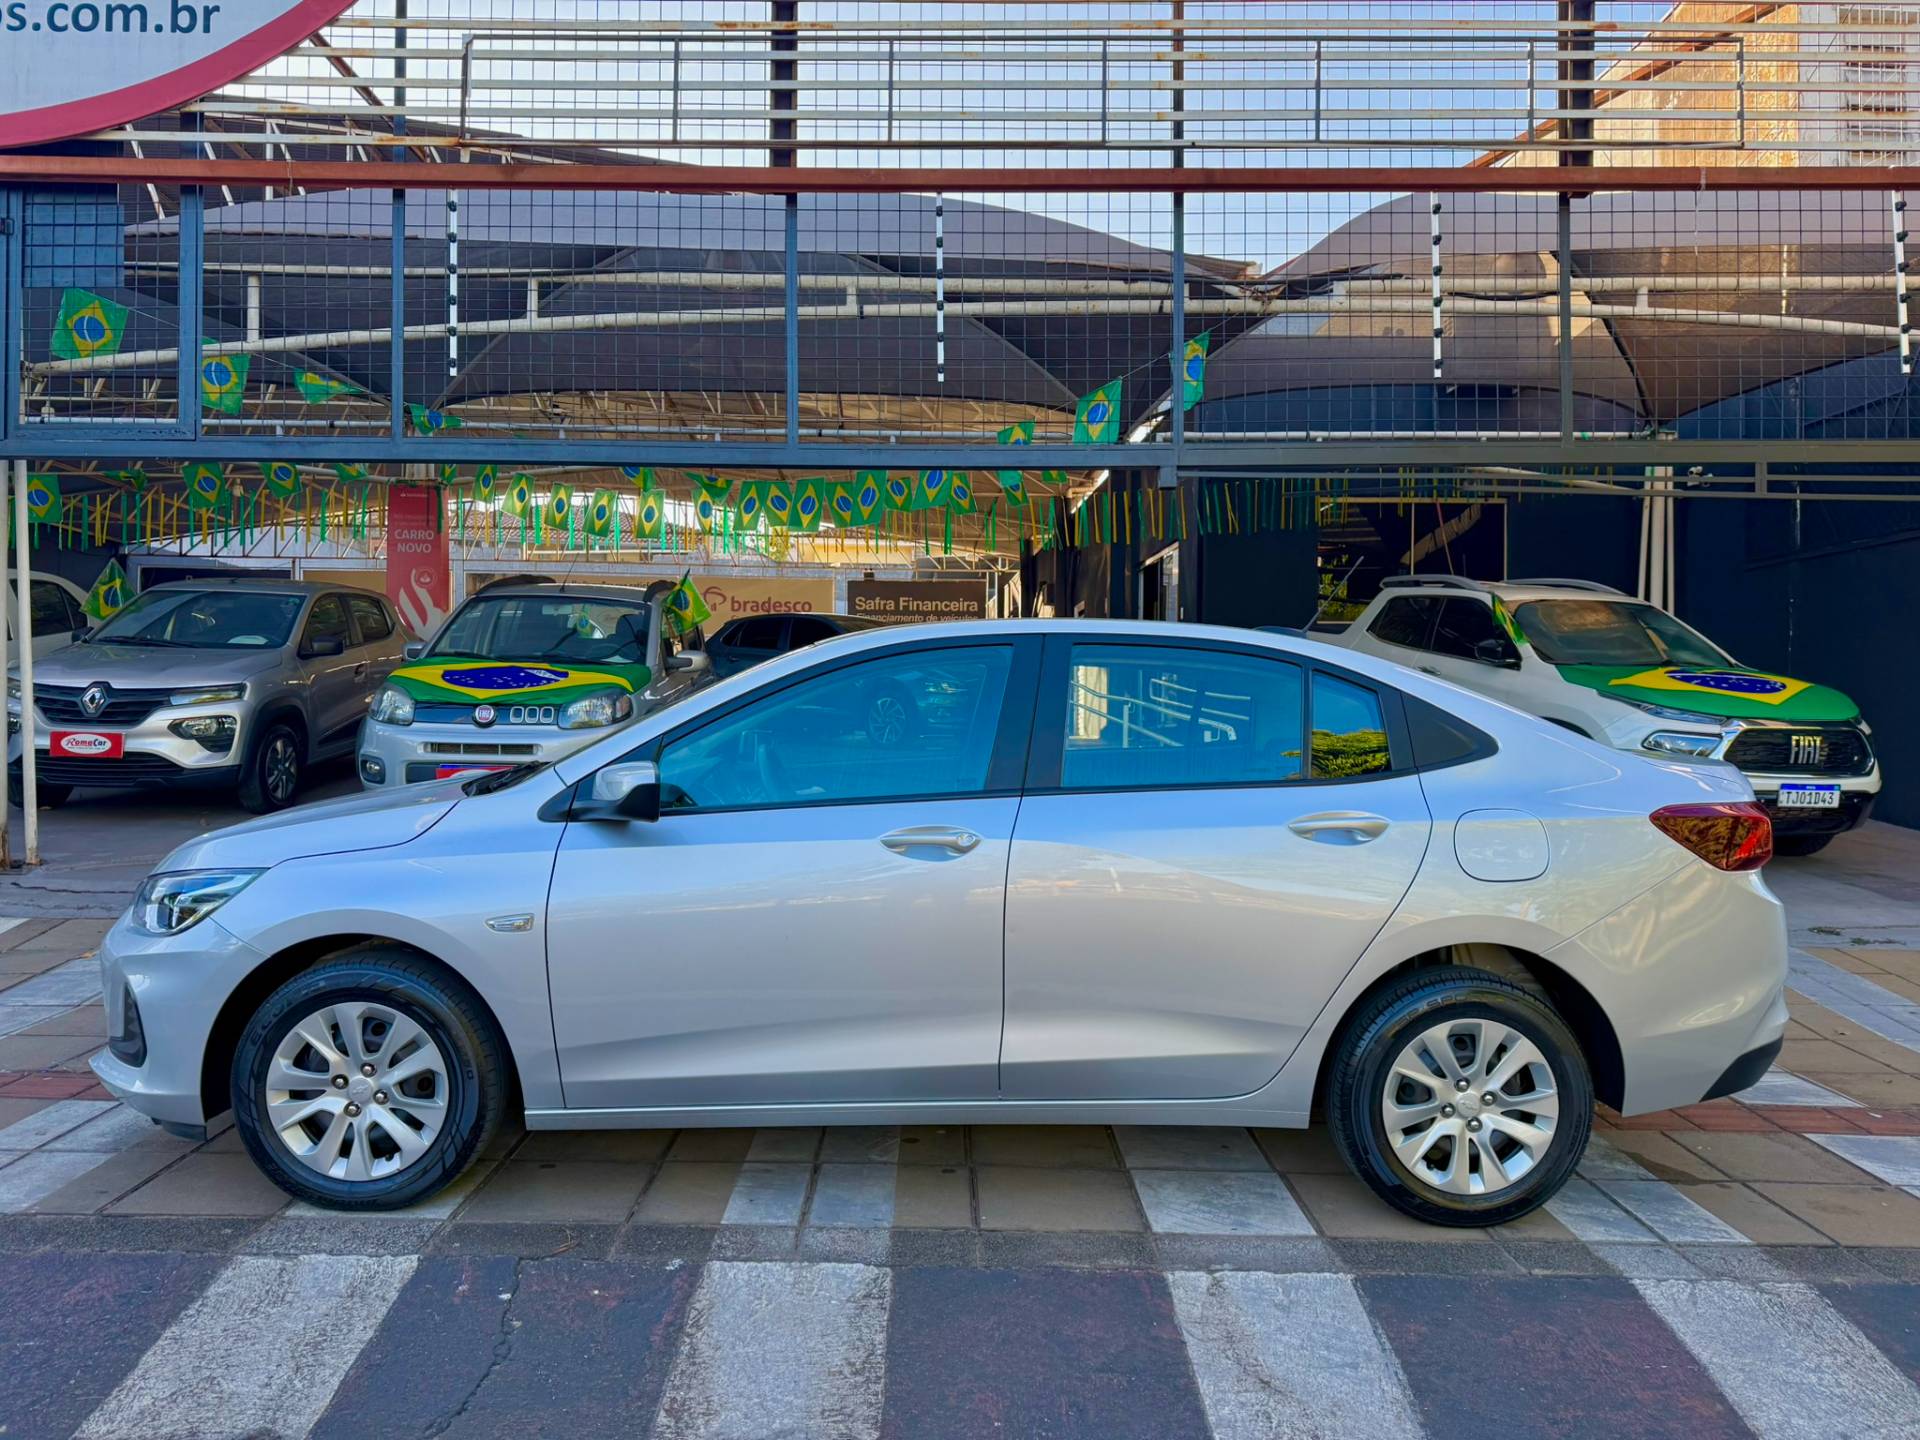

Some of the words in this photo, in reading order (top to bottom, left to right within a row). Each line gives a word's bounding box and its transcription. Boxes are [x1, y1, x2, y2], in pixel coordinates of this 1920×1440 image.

[0, 0, 220, 33] s.com.br
[395, 529, 434, 540] CARRO
[397, 543, 432, 553] NOVO
[731, 596, 812, 612] bradesco
[855, 597, 896, 611] Safra
[899, 597, 979, 612] Financeira
[1790, 735, 1822, 764] FIAT
